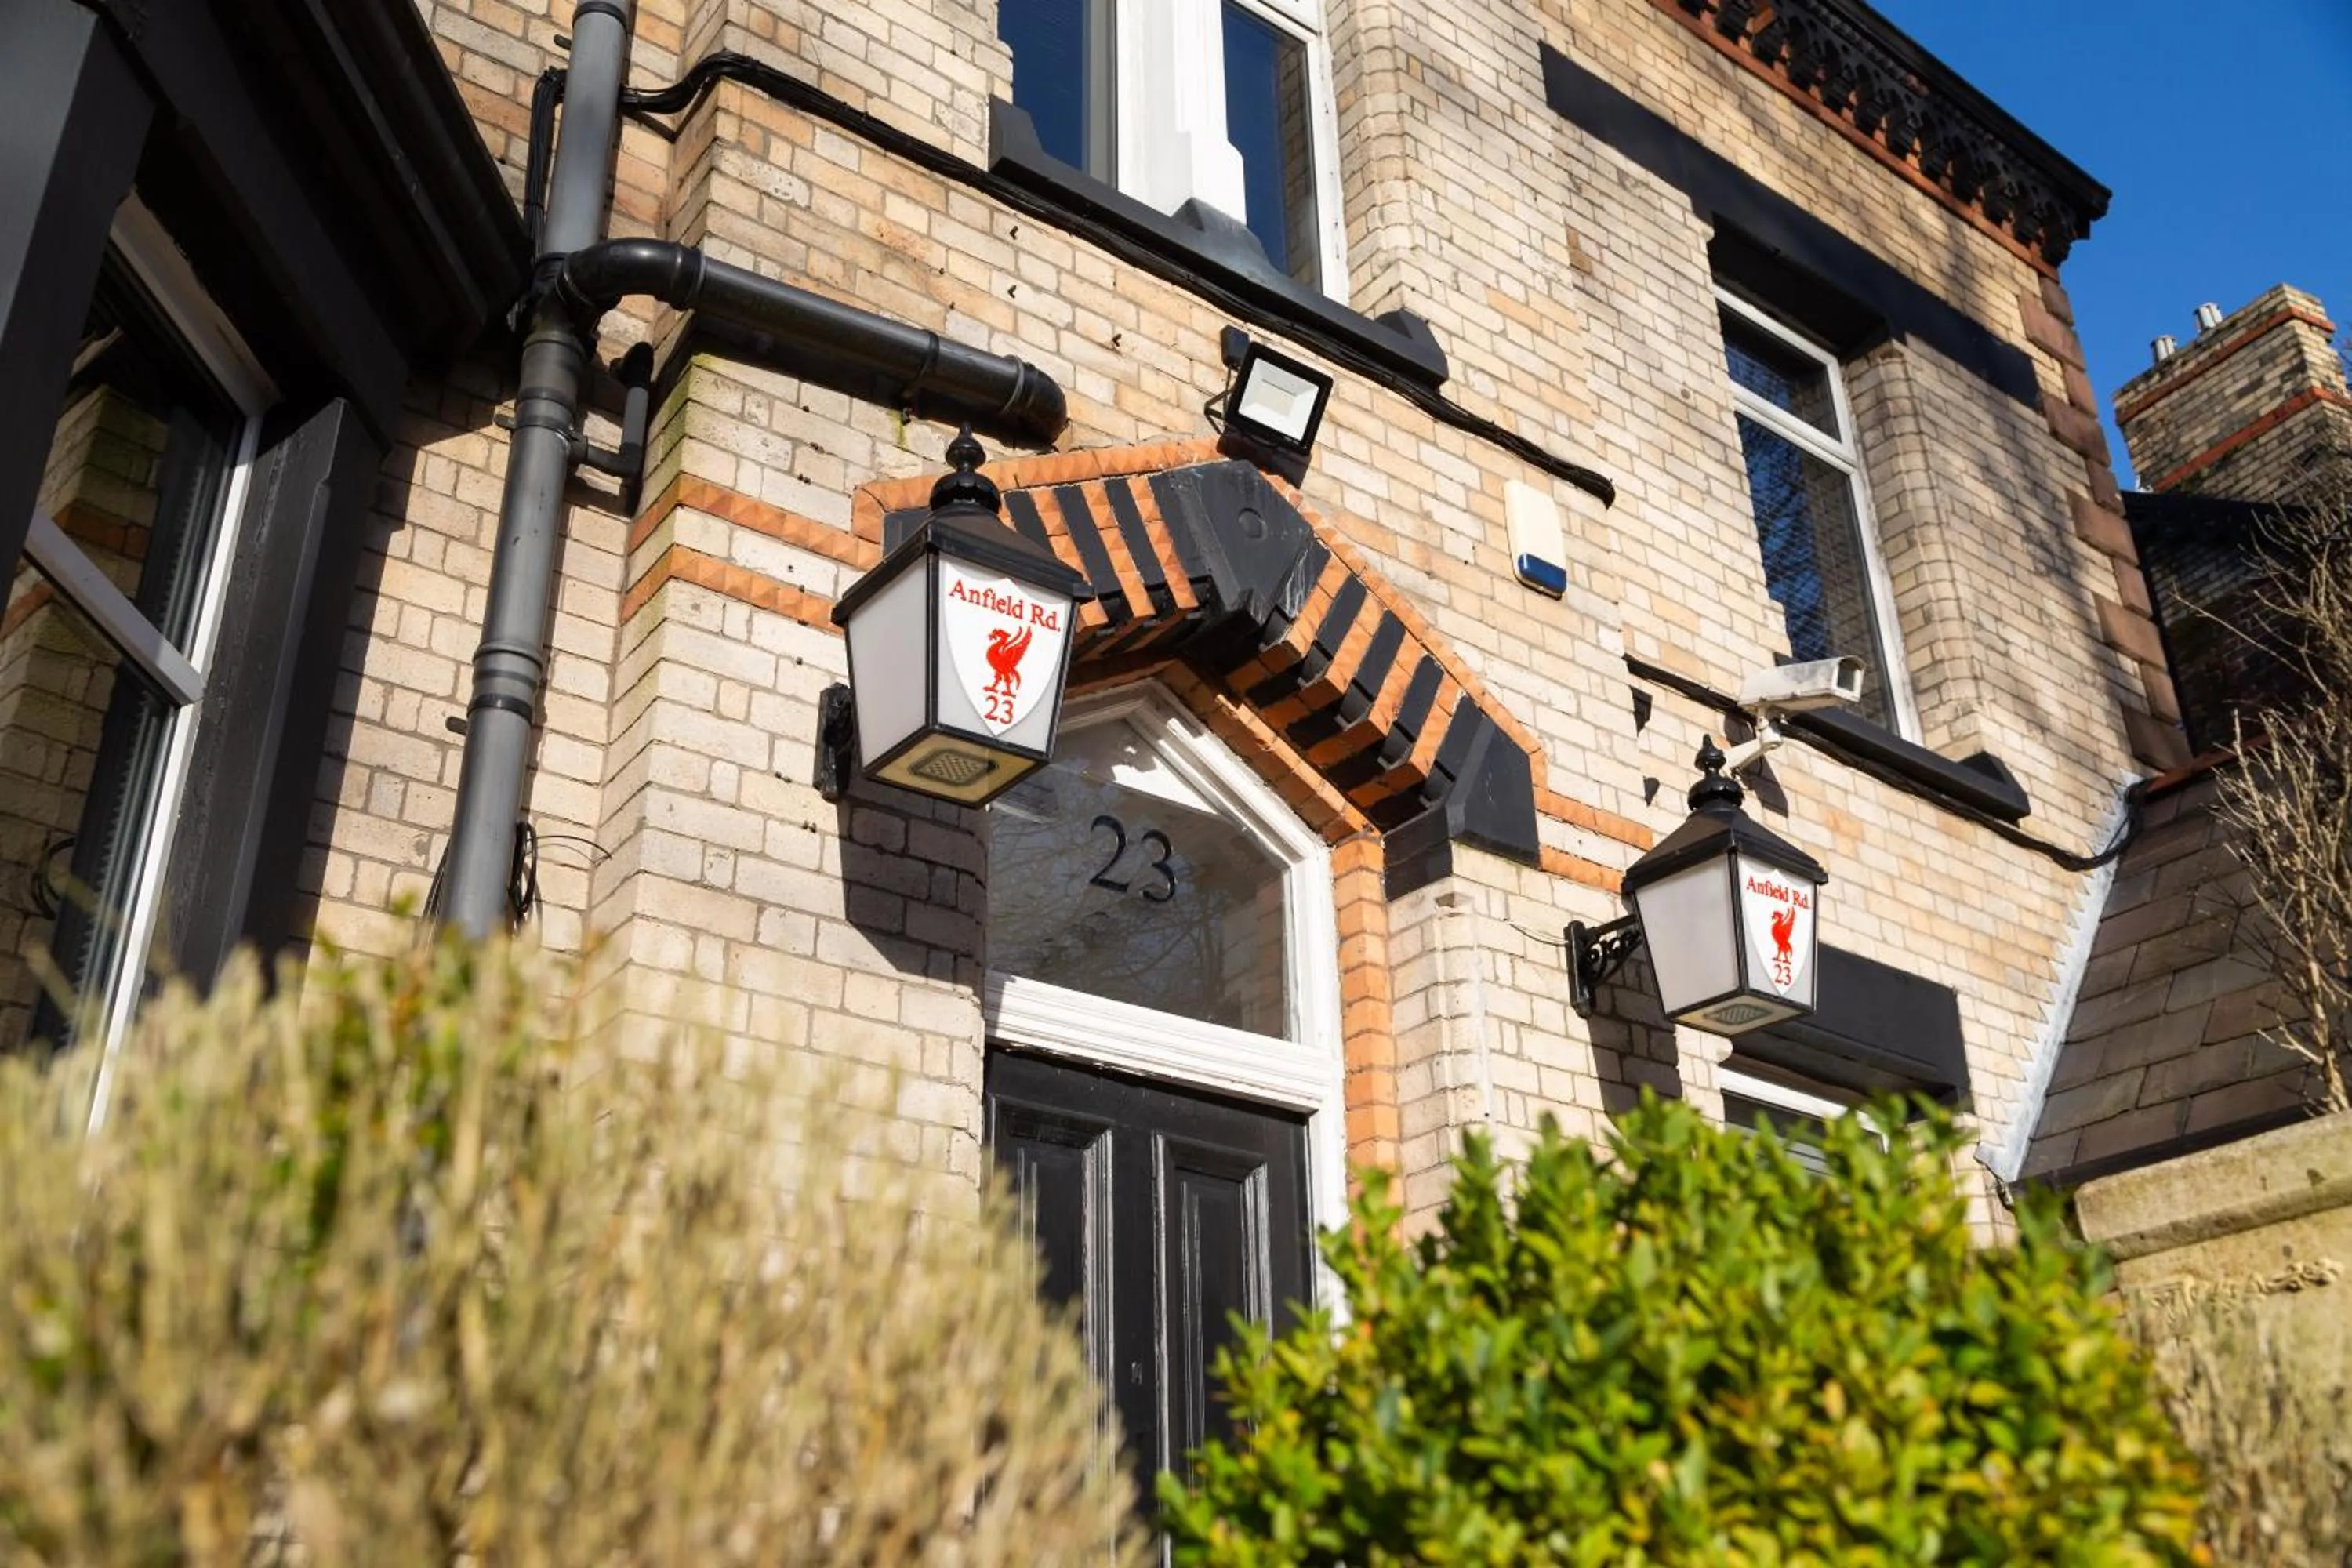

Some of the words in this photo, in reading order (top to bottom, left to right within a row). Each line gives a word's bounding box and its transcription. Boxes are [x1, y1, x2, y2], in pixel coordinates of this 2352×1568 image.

[949, 579, 1023, 619] Anfield
[1030, 603, 1061, 632] Rd.
[984, 695, 1014, 725] 23
[1090, 815, 1175, 902] 23
[1747, 877, 1788, 902] Anfield
[1774, 964, 1791, 985] 23
